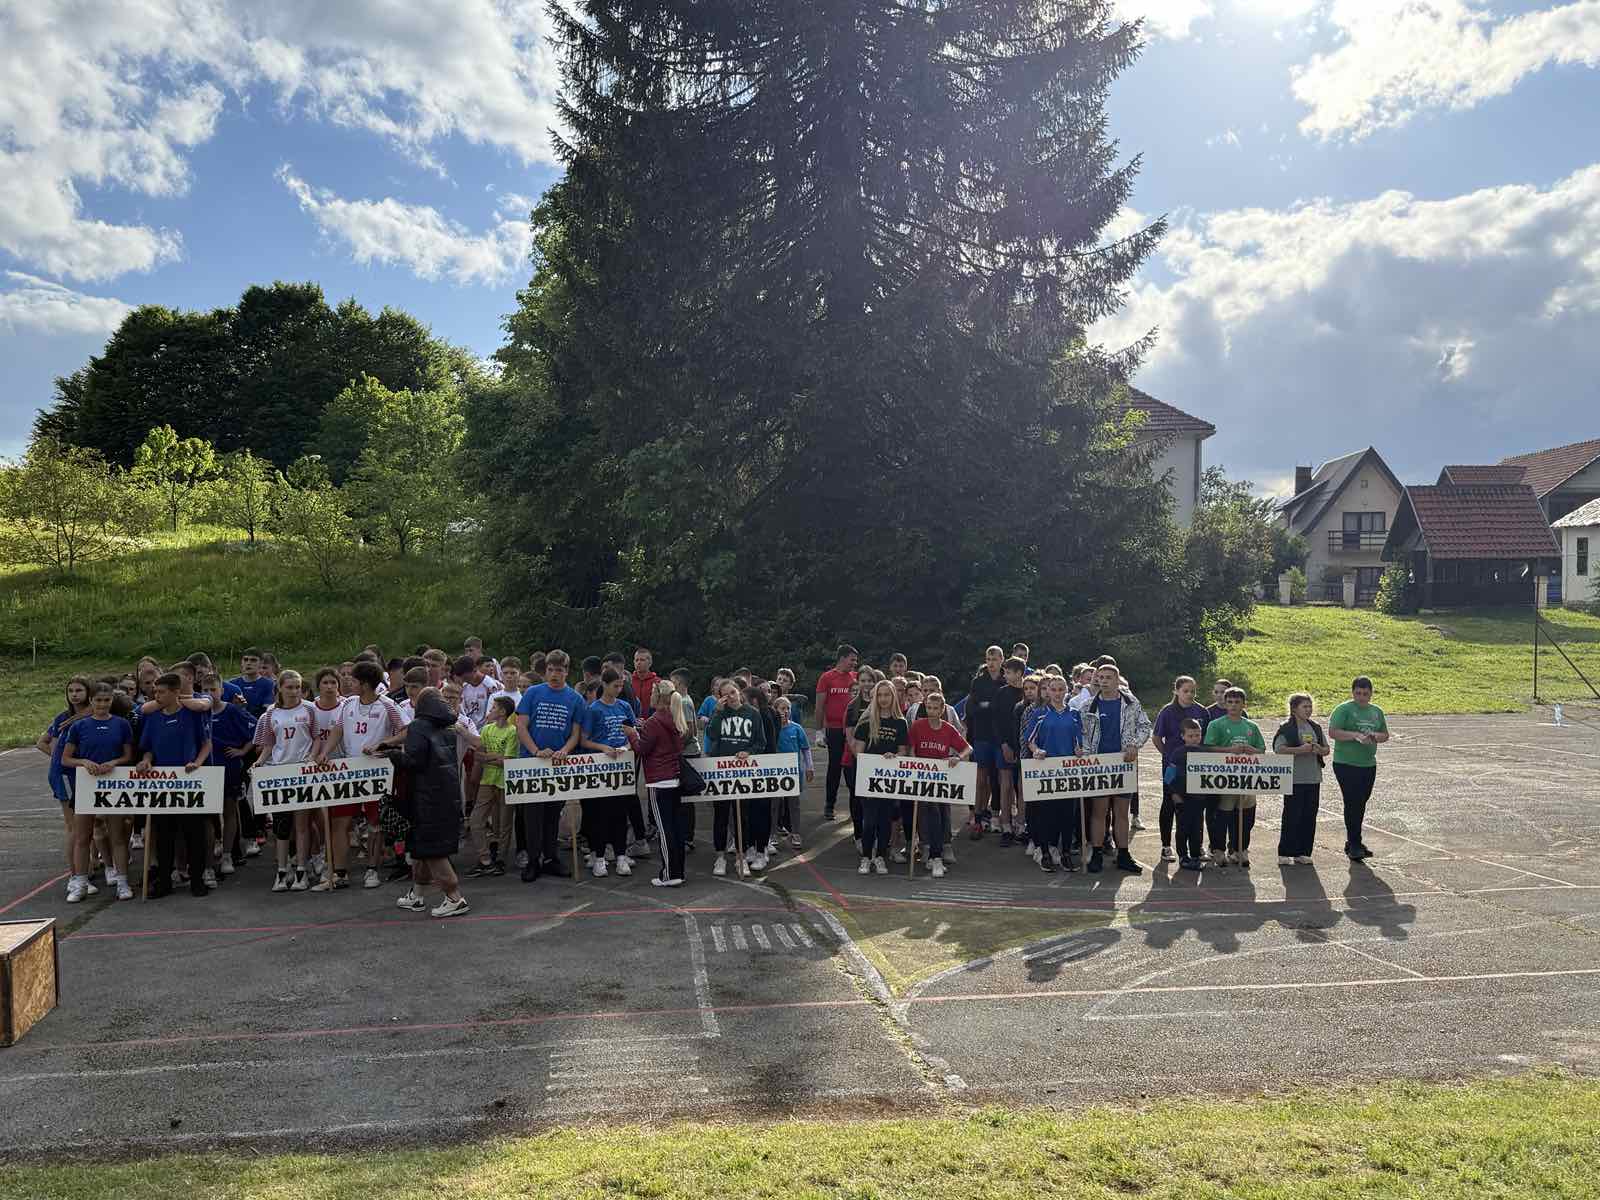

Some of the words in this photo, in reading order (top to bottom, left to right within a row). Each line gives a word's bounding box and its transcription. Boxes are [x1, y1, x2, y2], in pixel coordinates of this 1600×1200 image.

[283, 727, 296, 740] 17
[354, 721, 367, 734] 13
[720, 716, 752, 738] NYC
[551, 755, 594, 767] ШКОЛА
[717, 759, 758, 769] ШКОЛА
[899, 760, 939, 772] ШКОЛА
[1062, 757, 1101, 768] ШКОЛА
[1225, 756, 1260, 765] ШКОЛА
[301, 761, 349, 775] ШКОЛА
[507, 767, 550, 779] ВУЧИЋ
[553, 761, 633, 776] ВЕЛИЧКОВИЋ
[874, 768, 912, 778] МАЈОР
[917, 770, 948, 781] ИЛИЋ
[1024, 767, 1078, 779] НЕДЕЉКО
[1080, 763, 1134, 776] КОШАНИН
[1187, 764, 1239, 773] СВЕТОЗАР
[1240, 765, 1292, 775] МАРКОВИЋ
[129, 770, 178, 780] ШКОЛА
[257, 776, 307, 789] СРЕТЕН
[311, 767, 390, 784] ЛАЗАРЕВИЋ
[97, 780, 135, 789] МИЋО
[138, 780, 202, 789] МАТОВИЋ
[505, 771, 635, 796] МЕЂУРЕЧЈЕ
[868, 777, 965, 800] КУШИЋИ
[1037, 773, 1124, 795] ДЕВИЋИ
[1199, 774, 1281, 790] КОВИЉЕ
[261, 778, 388, 806] ПРИЛИКЕ
[94, 791, 205, 808] КАТИЋИ
